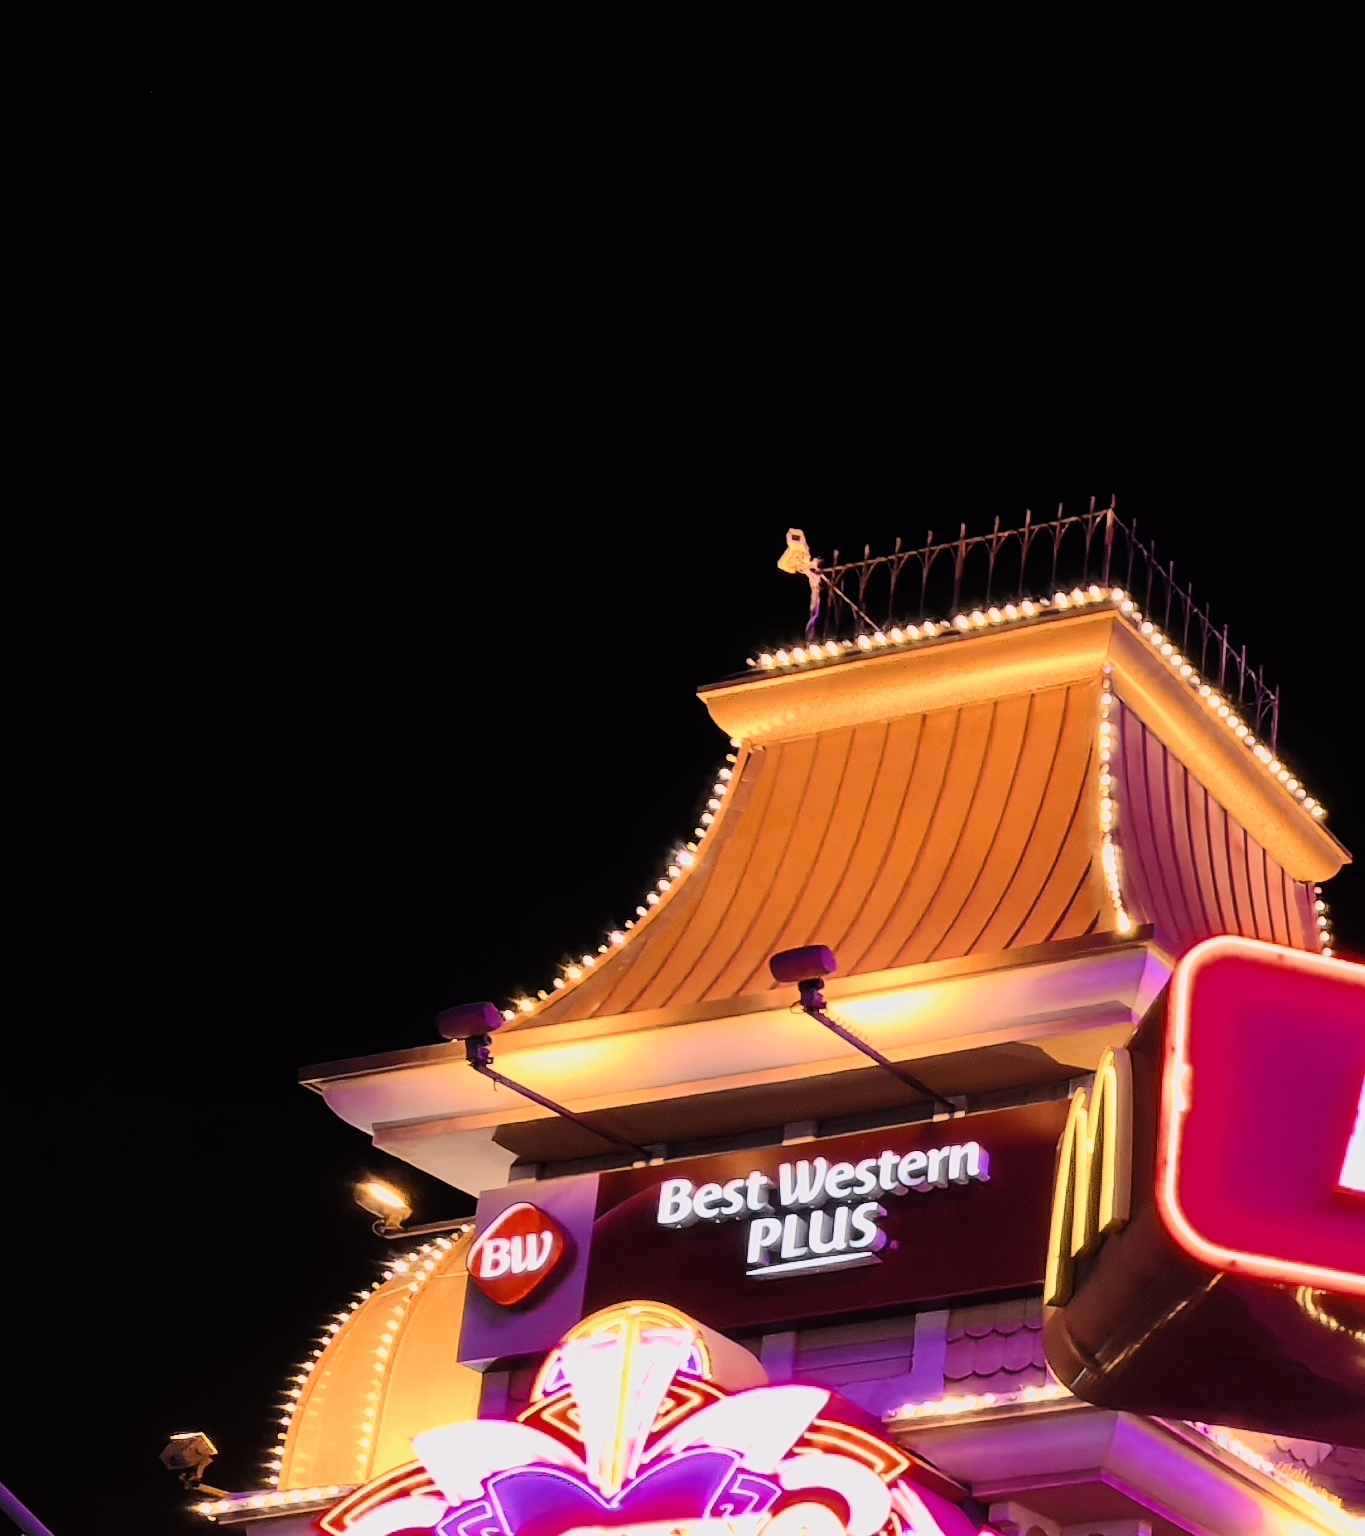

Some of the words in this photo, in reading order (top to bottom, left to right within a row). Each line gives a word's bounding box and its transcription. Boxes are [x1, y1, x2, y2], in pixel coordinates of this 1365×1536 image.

[657, 1172, 770, 1226] Best
[778, 1140, 986, 1206] Western
[480, 1230, 553, 1279] BW
[747, 1202, 882, 1265] PLUS
